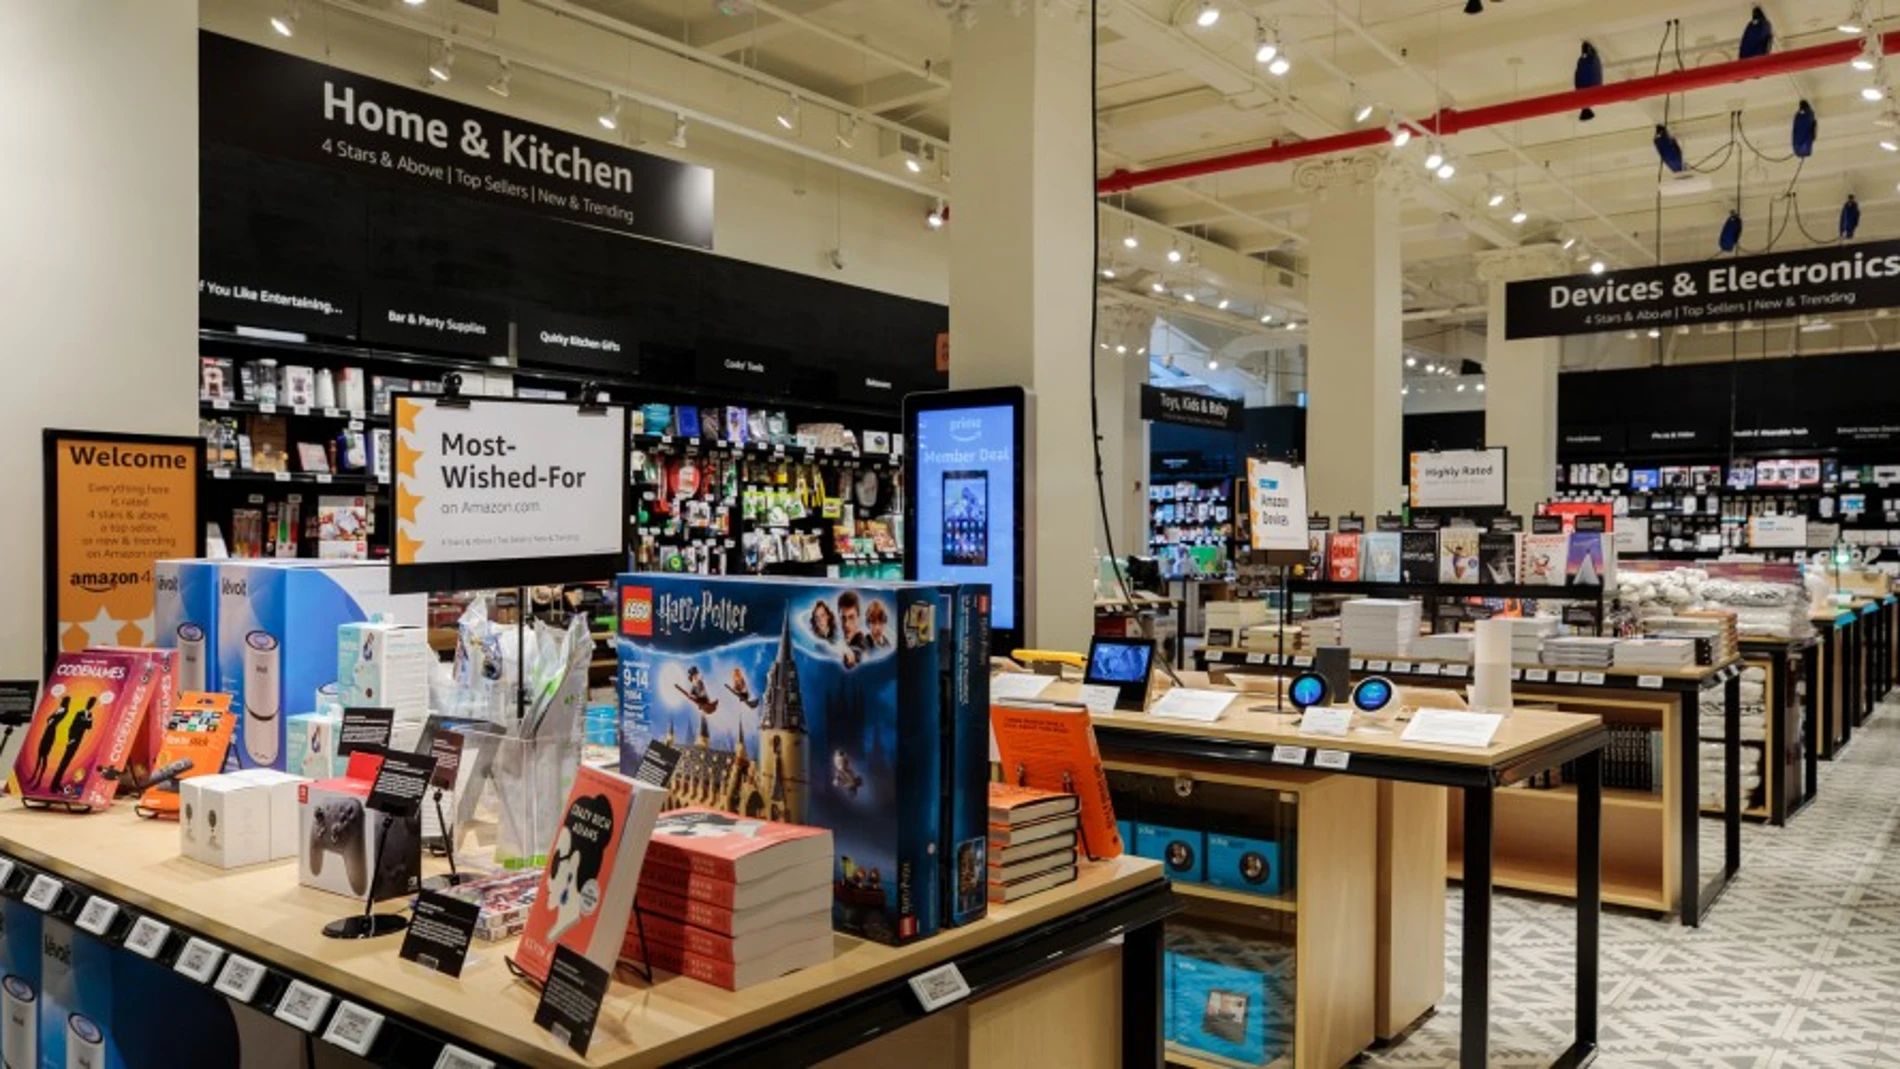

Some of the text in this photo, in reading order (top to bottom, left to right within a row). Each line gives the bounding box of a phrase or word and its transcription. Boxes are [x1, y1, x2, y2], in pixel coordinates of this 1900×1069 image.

[323, 81, 633, 193] Home & Kitchen
[322, 138, 333, 154] 4
[337, 140, 377, 166] Stars
[380, 151, 393, 168] &
[397, 155, 443, 181] Above
[456, 168, 482, 191] Top
[484, 175, 529, 202] Sellers
[538, 188, 566, 207] New
[569, 194, 580, 211] &
[584, 197, 634, 225] Trending
[1550, 251, 1900, 309] Devices & Electronics
[208, 282, 231, 297] You
[233, 286, 258, 300] Like
[1584, 315, 1592, 325] 4
[1594, 311, 1622, 326] Stars
[1624, 311, 1634, 322] &
[1636, 308, 1672, 322] Above
[1682, 304, 1704, 319] Top
[1706, 301, 1745, 315] Sellers
[1754, 297, 1782, 310] New
[1785, 296, 1796, 308] &
[1800, 291, 1857, 307] Trending
[388, 310, 487, 335] Bar & Party Supplies
[540, 330, 621, 353] Quirky Kitchen Gifts
[1182, 396, 1200, 412] Kids
[1201, 401, 1208, 413] &
[1209, 401, 1230, 420] Baby
[442, 433, 516, 456] Most-
[70, 446, 187, 469] Welcome
[923, 447, 1010, 463] Member Deal
[441, 465, 586, 489] Wished-For
[1425, 466, 1493, 479] Highly Rated
[88, 483, 146, 496] Everything
[121, 498, 148, 507] rated
[441, 500, 541, 515] on Amazon.com
[88, 509, 95, 518] 4
[126, 510, 134, 519] &
[121, 537, 130, 546] &
[134, 537, 176, 548] trending
[70, 571, 139, 587] amazon
[624, 602, 652, 619] LEGO
[658, 589, 747, 635] Harry Potter
[57, 664, 125, 679] CODENAMES
[623, 668, 649, 688] 9-14
[110, 686, 146, 762] CODENAMES
[572, 822, 599, 842] ASIANS
[592, 814, 612, 832] RICH
